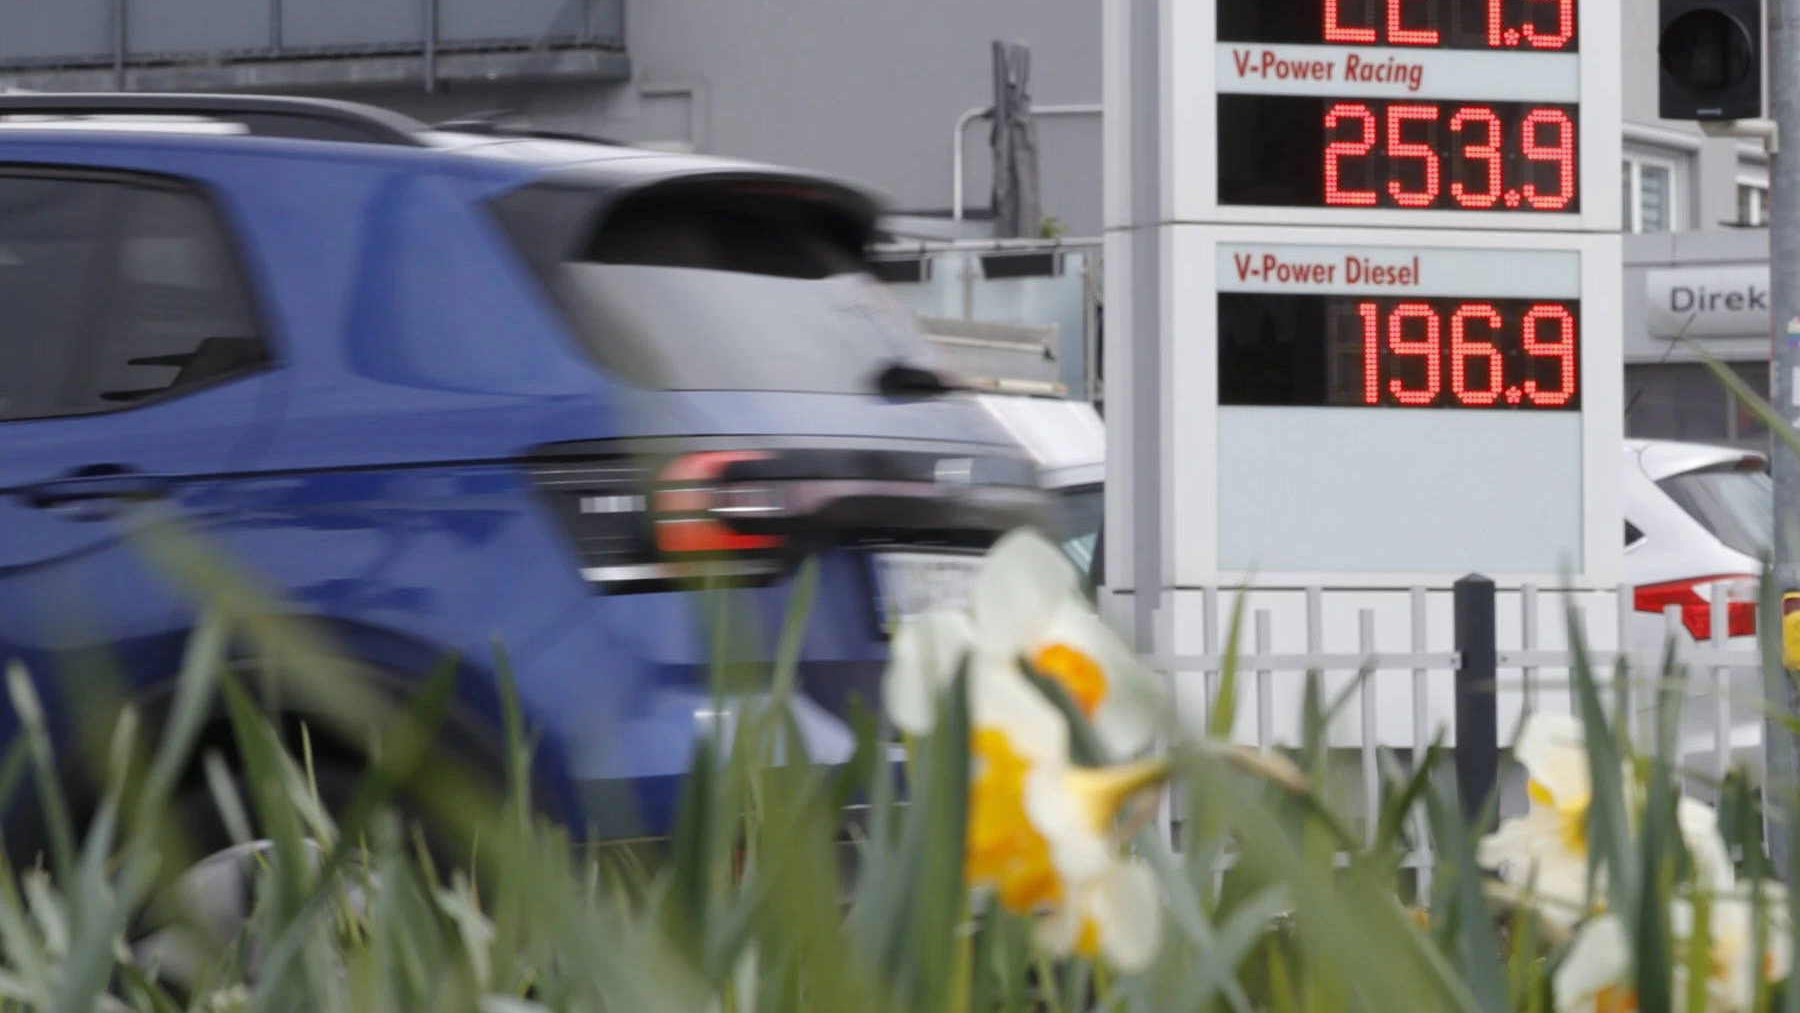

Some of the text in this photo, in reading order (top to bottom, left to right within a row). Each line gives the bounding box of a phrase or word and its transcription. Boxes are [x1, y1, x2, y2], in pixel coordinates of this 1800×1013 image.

[1233, 51, 1424, 91] V-Power Racing
[1324, 103, 1575, 210] 253.9
[1234, 254, 1420, 287] V-Power Diesel
[1359, 303, 1576, 406] 196.9
